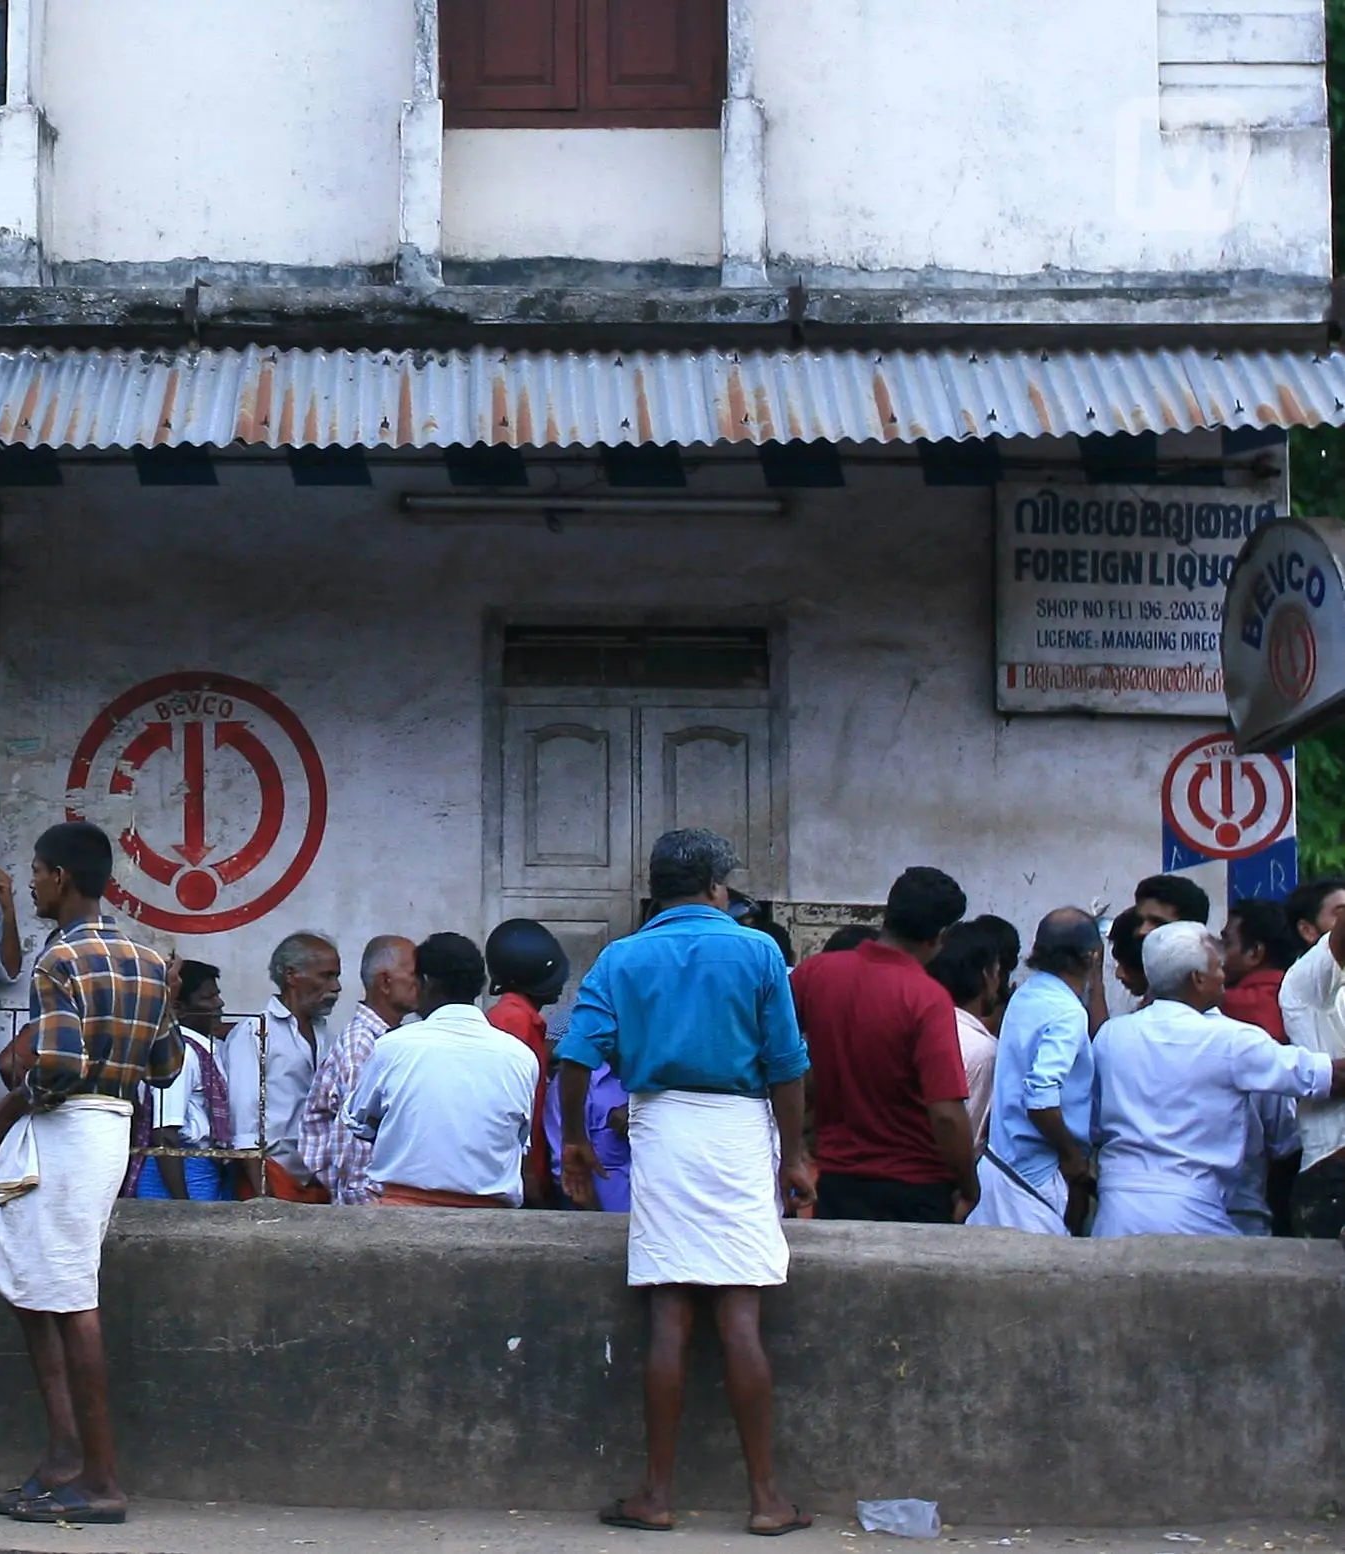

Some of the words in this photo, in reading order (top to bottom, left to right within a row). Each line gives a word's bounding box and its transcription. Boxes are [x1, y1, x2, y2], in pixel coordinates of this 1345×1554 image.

[1014, 548, 1142, 584] FOREIGN
[1149, 553, 1235, 591] LIQUO
[1036, 599, 1078, 618] SHOP
[1241, 552, 1325, 649] BEVCO
[1102, 630, 1176, 650] MANAGING
[154, 696, 234, 721] BEVCO
[1203, 742, 1235, 759] BEVC
